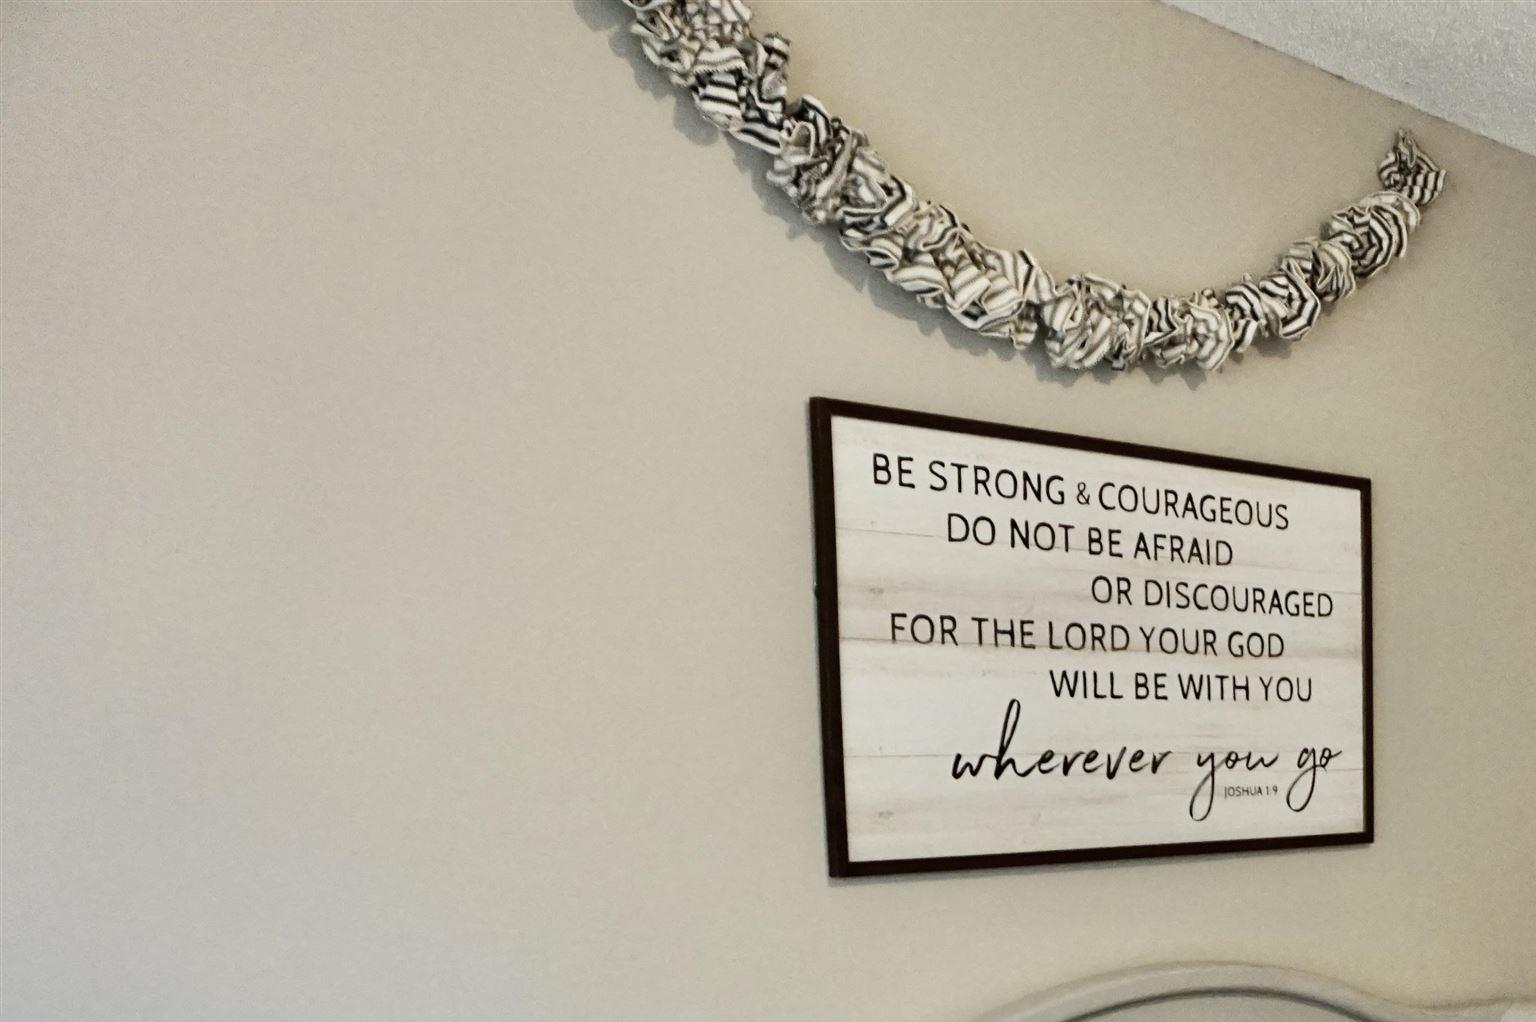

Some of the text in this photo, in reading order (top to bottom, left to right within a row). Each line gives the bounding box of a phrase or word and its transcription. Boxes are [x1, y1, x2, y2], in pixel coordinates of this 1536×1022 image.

[872, 452, 1289, 531] BE STRONG & COURAGEOUS
[947, 512, 1233, 567] DO NOT BE AFRAID
[1091, 575, 1334, 618] OR DISCOURAGED
[890, 612, 1285, 659] FOR THE LORD YOUR GOD
[1049, 669, 1312, 703] WILL BE WITH YOU
[951, 698, 1343, 823] wherever you go
[1224, 786, 1263, 799] JOSHUA
